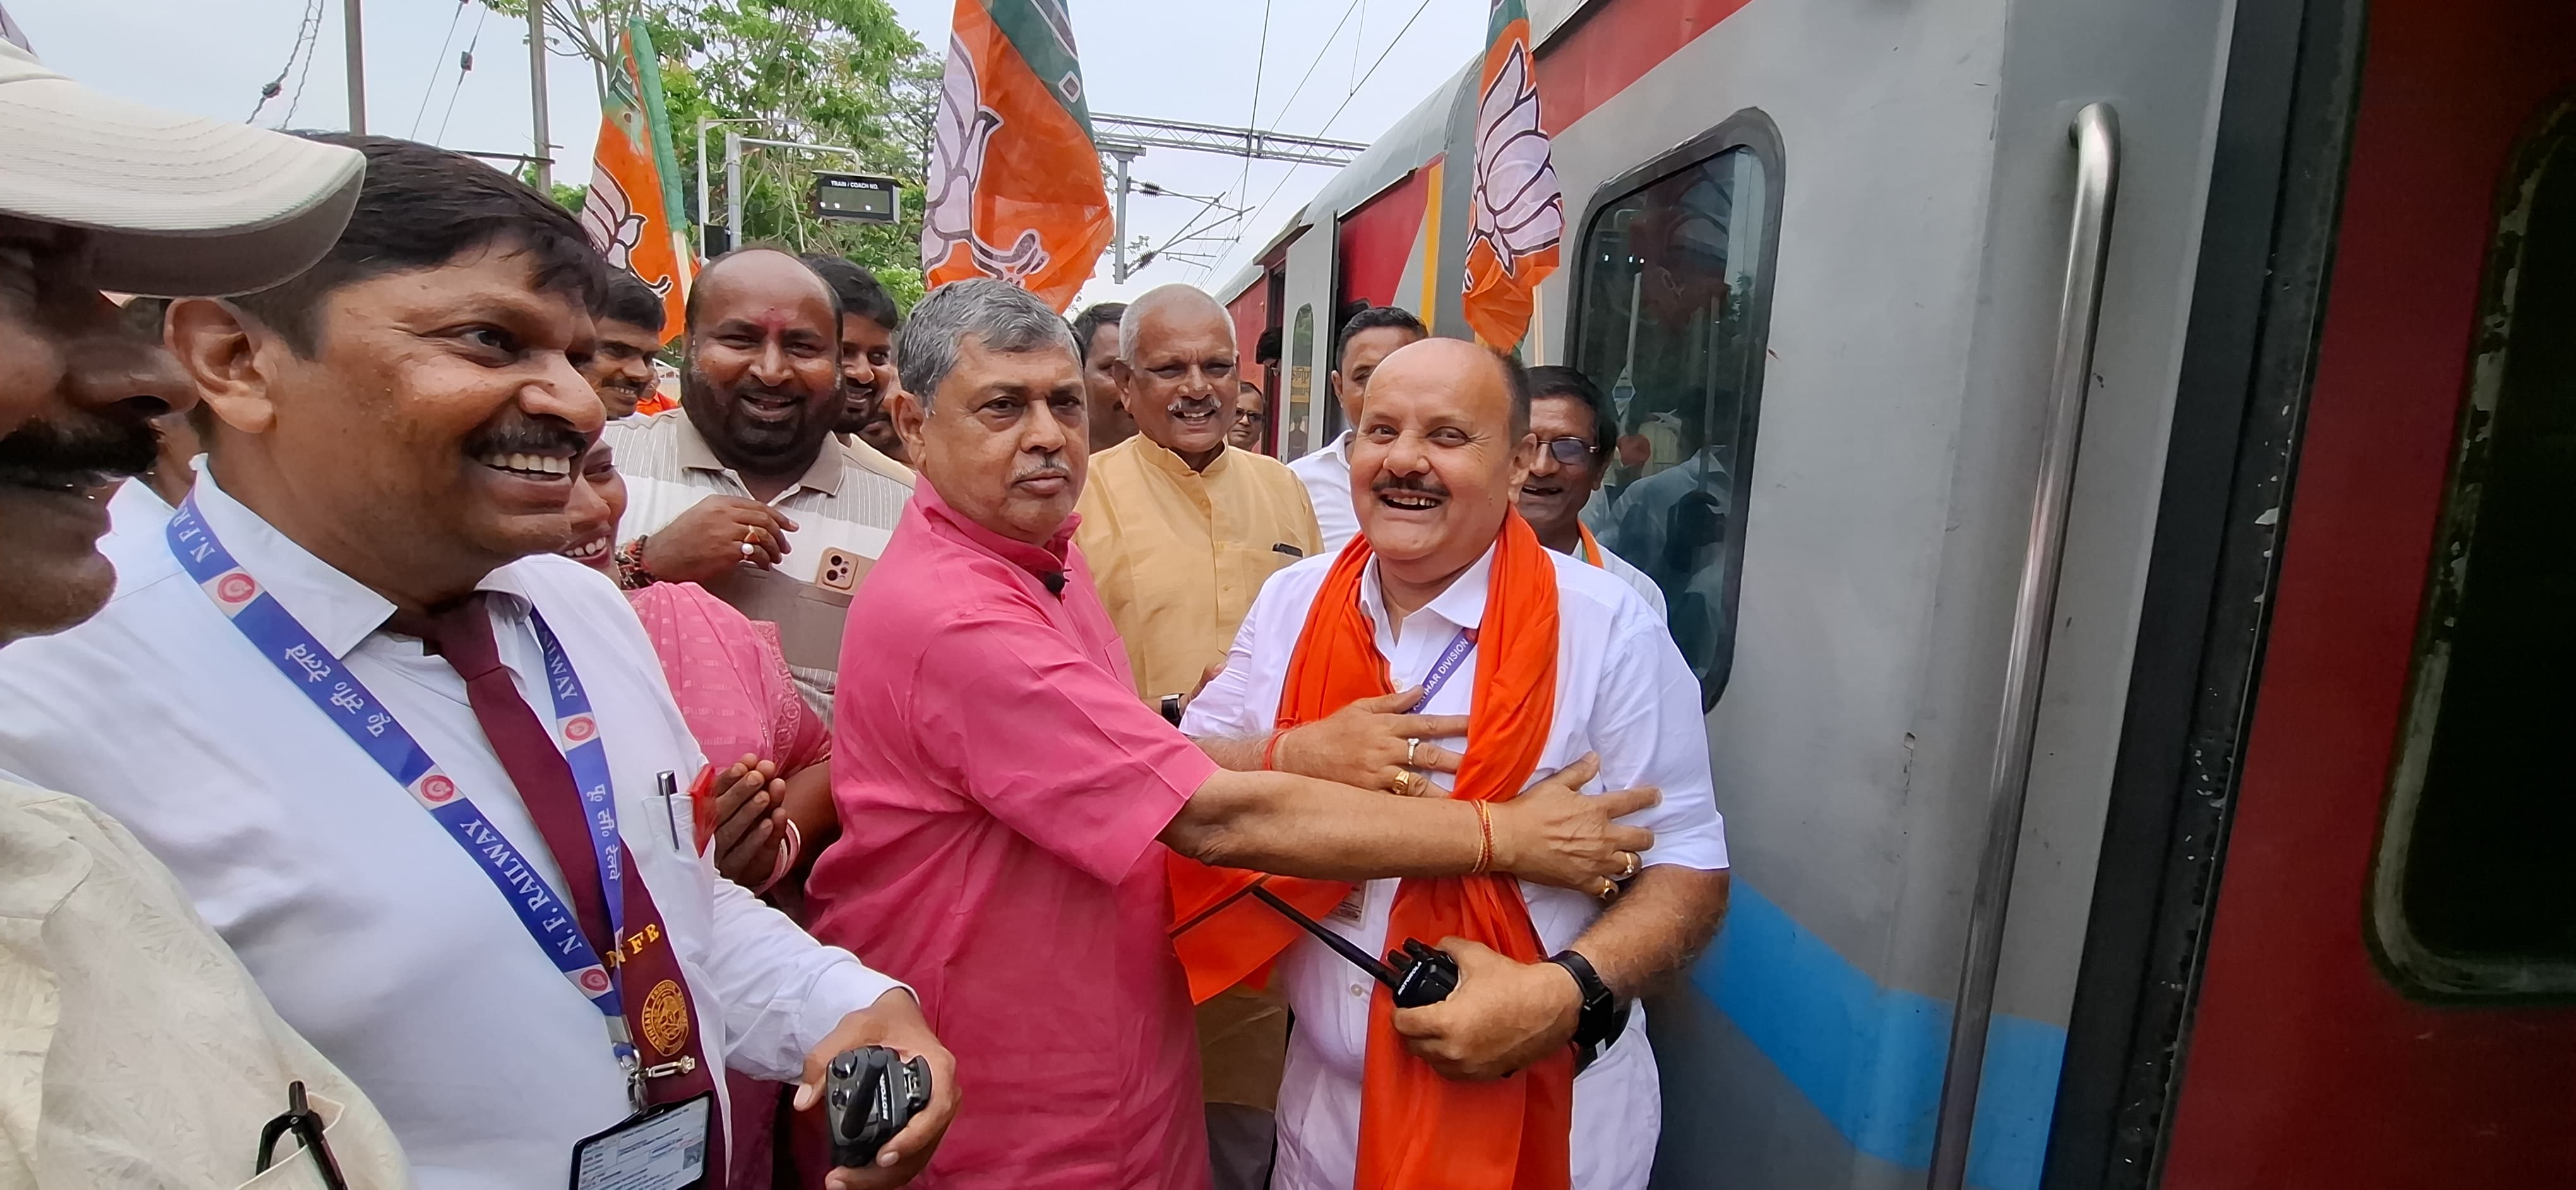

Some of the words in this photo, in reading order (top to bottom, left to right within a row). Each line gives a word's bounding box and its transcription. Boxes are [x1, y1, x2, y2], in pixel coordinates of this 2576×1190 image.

[284, 644, 331, 683] रेलवे
[1438, 638, 1469, 675] DIVISION
[460, 819, 551, 912] RAILWAY
[605, 844, 620, 882] रेलवे
[1397, 961, 1422, 996] MOTOROLA
